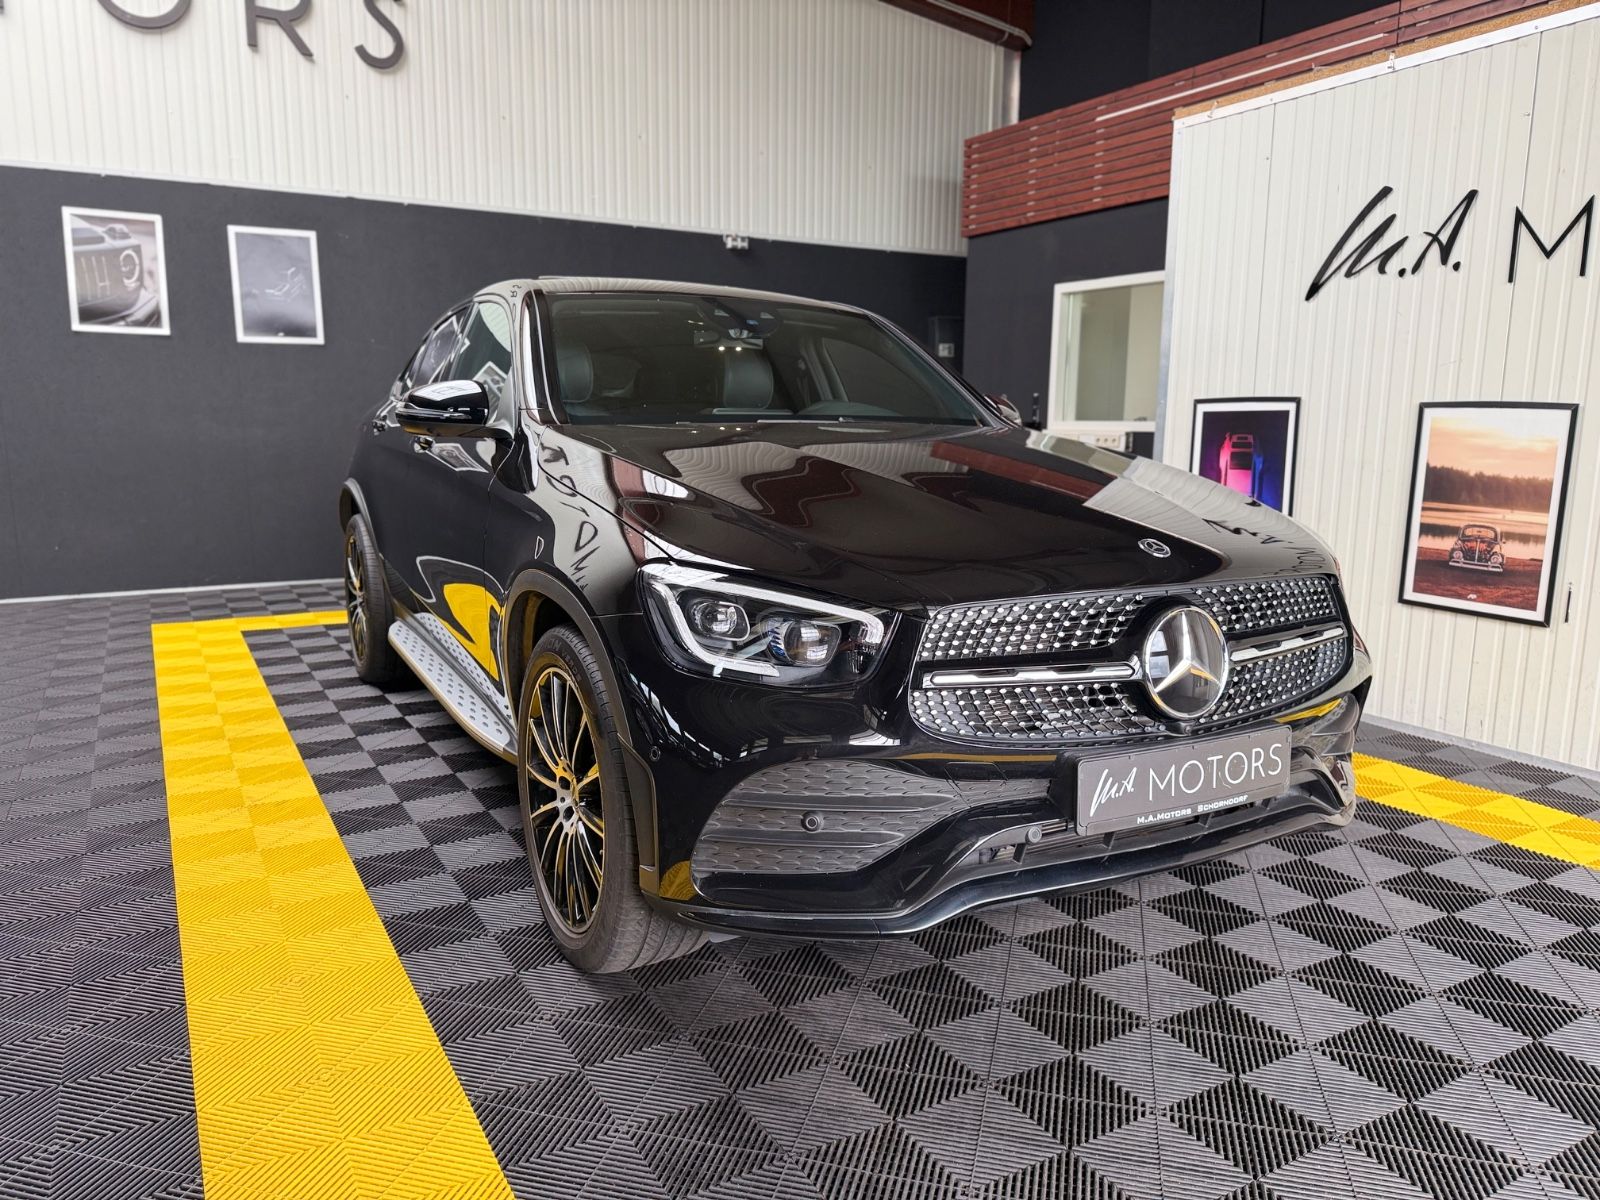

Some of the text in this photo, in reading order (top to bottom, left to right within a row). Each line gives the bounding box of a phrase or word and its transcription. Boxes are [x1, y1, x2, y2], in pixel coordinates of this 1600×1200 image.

[1305, 185, 1595, 301] M.A. M
[1090, 743, 1282, 817] M.A. MOTORS
